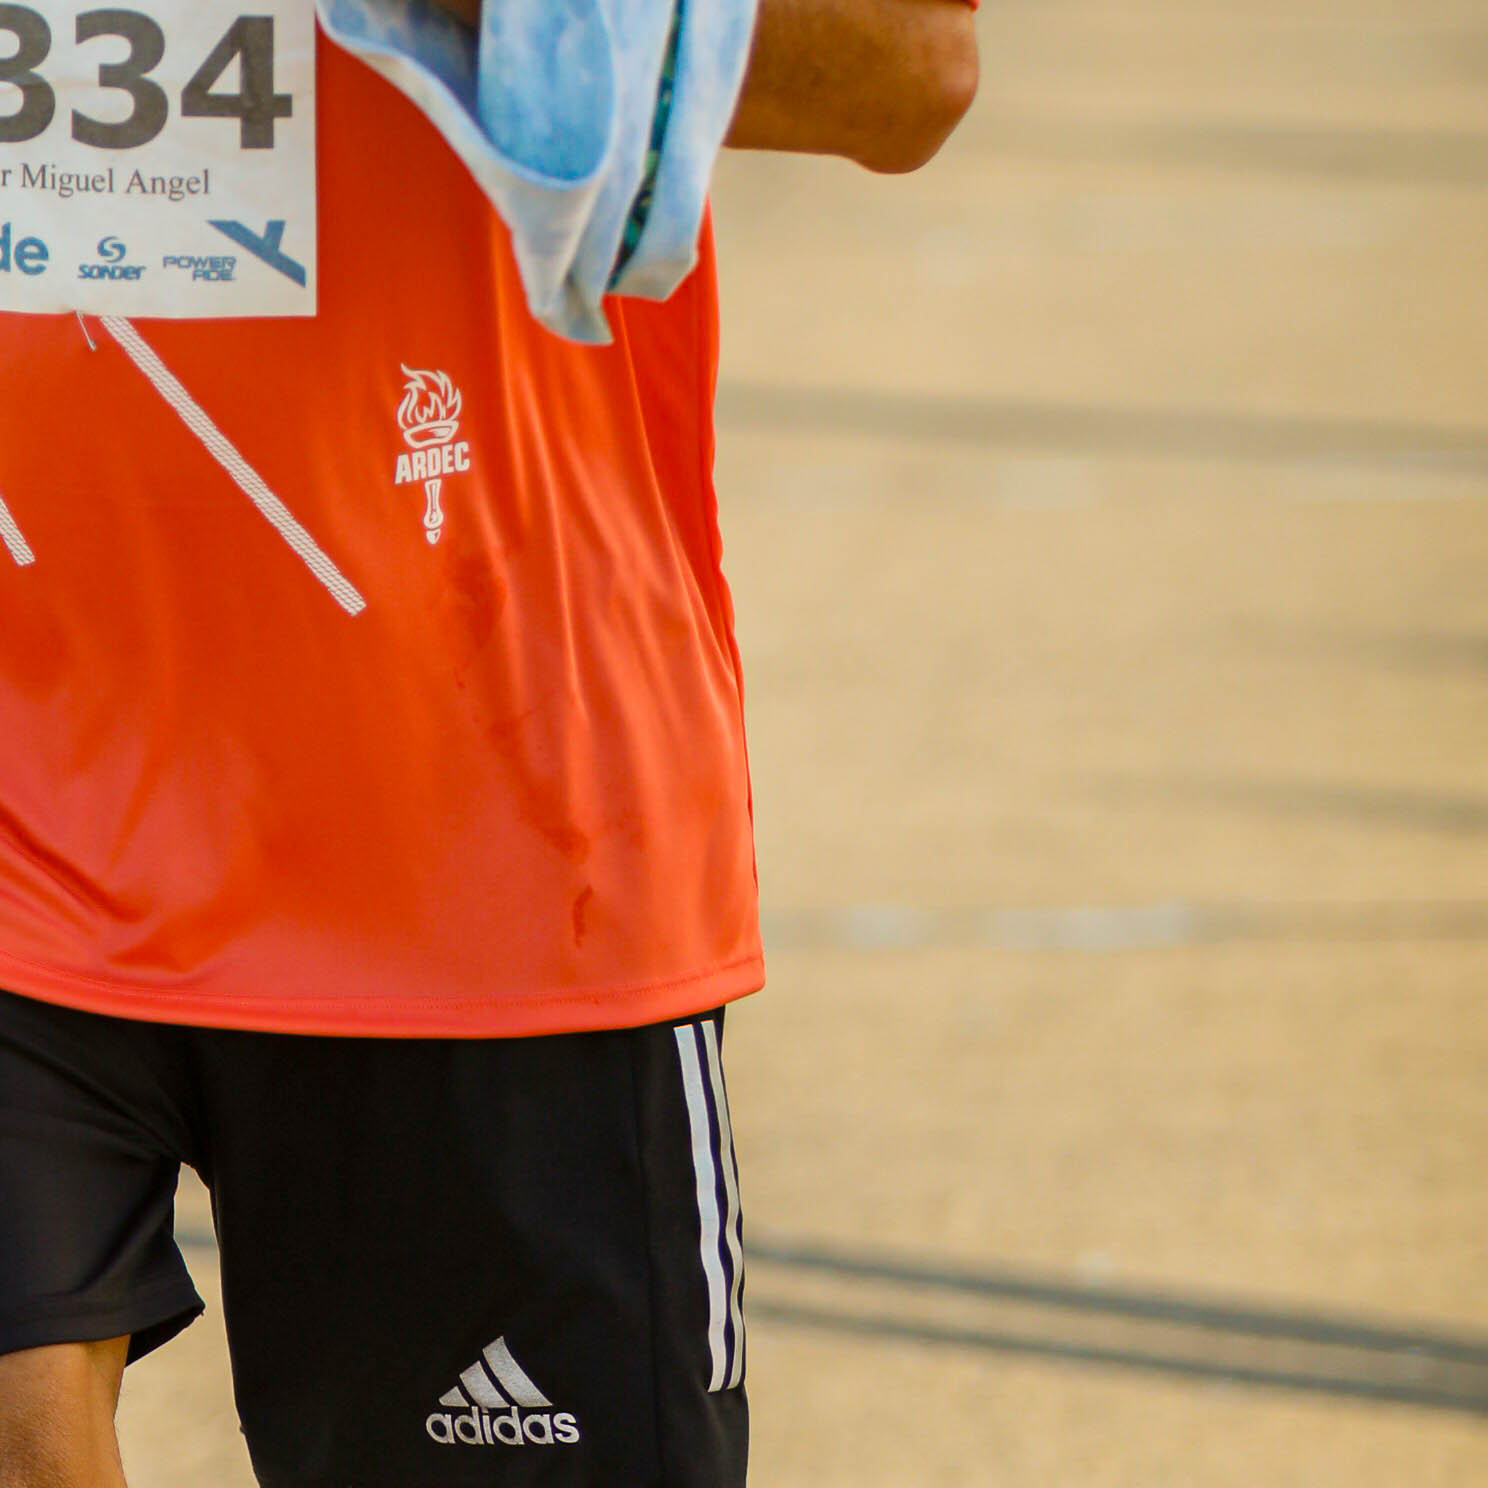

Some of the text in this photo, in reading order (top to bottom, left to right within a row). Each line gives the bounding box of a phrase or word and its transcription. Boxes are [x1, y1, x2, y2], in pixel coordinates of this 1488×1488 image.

[20, 162, 114, 198] Miguel
[125, 168, 211, 201] Angel
[162, 255, 237, 270] POWER
[394, 441, 471, 485] ARDEC
[425, 1406, 581, 1445] adidas
